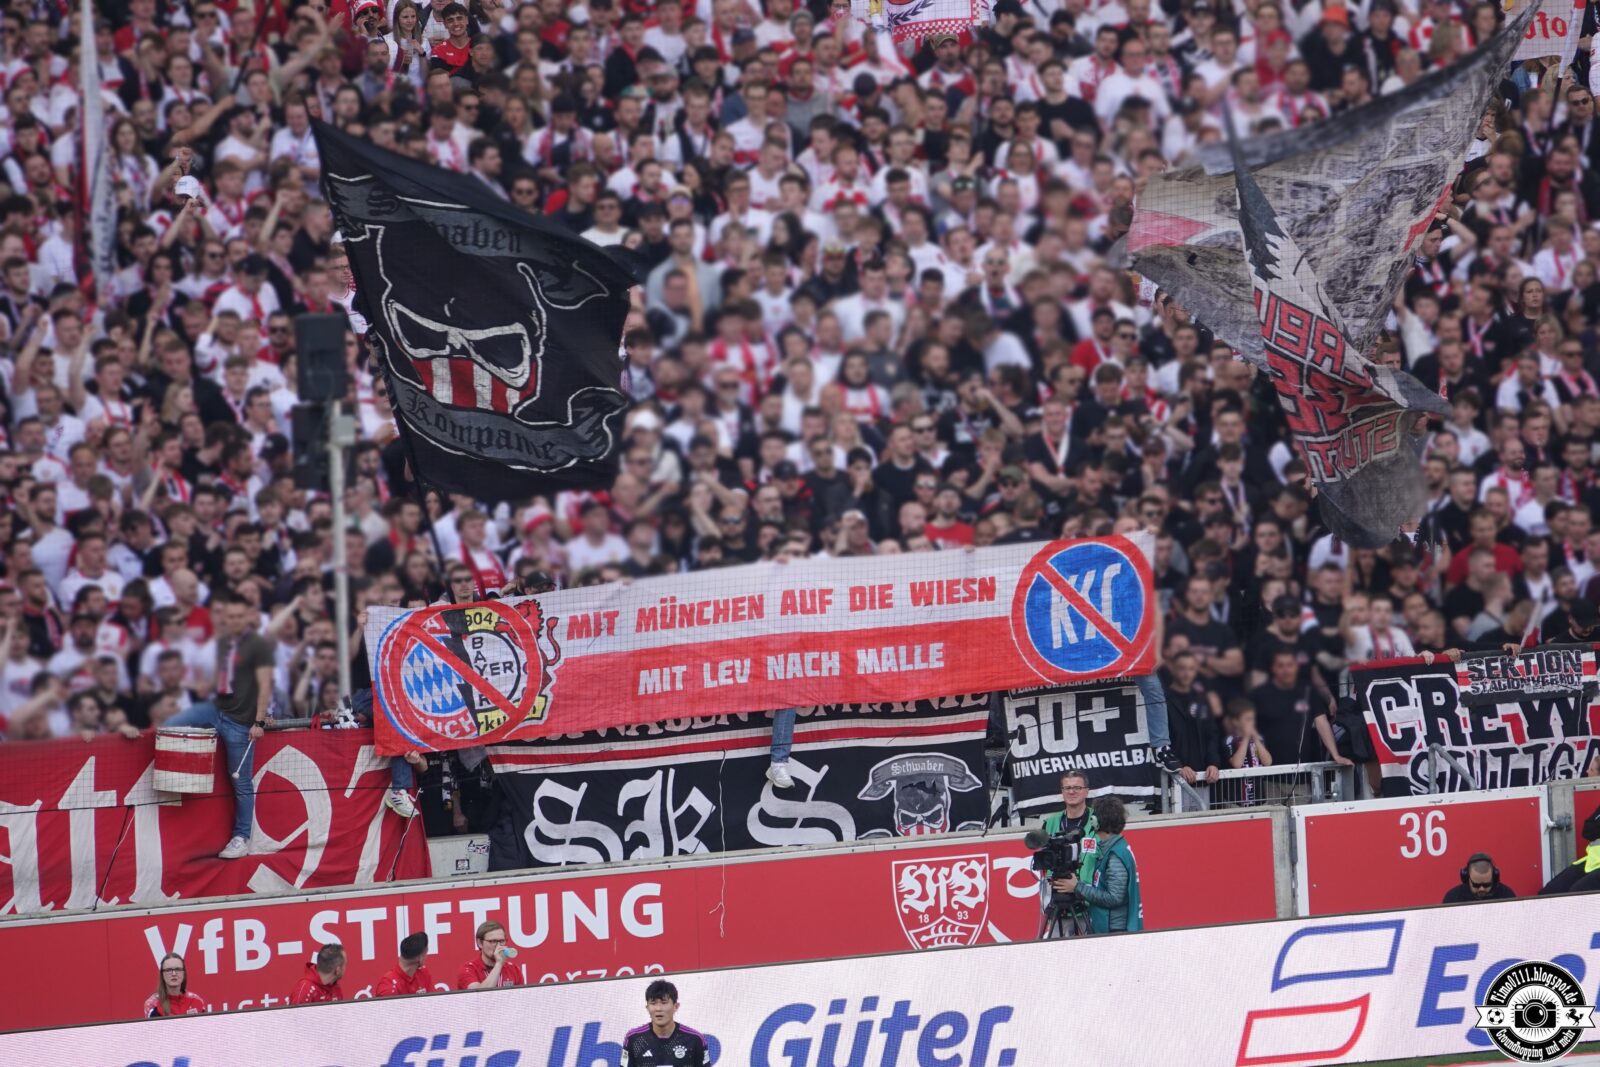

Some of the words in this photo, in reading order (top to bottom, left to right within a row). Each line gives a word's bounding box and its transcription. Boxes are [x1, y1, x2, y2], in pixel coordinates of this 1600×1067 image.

[566, 609, 619, 641] MIT
[635, 594, 765, 633] MÜNCHEN
[780, 588, 834, 616] AUF
[849, 583, 894, 613] DIE
[910, 576, 997, 606] WIESN
[637, 665, 687, 696] MIT
[702, 659, 751, 688] LEV
[767, 652, 841, 680] NACH
[857, 642, 945, 674] MALLE
[1467, 650, 1583, 682] SEKTION
[1004, 687, 1150, 759] 50+1
[1366, 672, 1592, 756] CREW
[890, 757, 946, 777] Schwaben
[1012, 748, 1163, 779] UNVERHANDELBA
[1399, 810, 1448, 859] 36
[144, 881, 664, 976] VfB-STIFTUNG
[918, 913, 930, 924] 18
[957, 910, 969, 921] 93
[750, 996, 1018, 1067] Güter.
